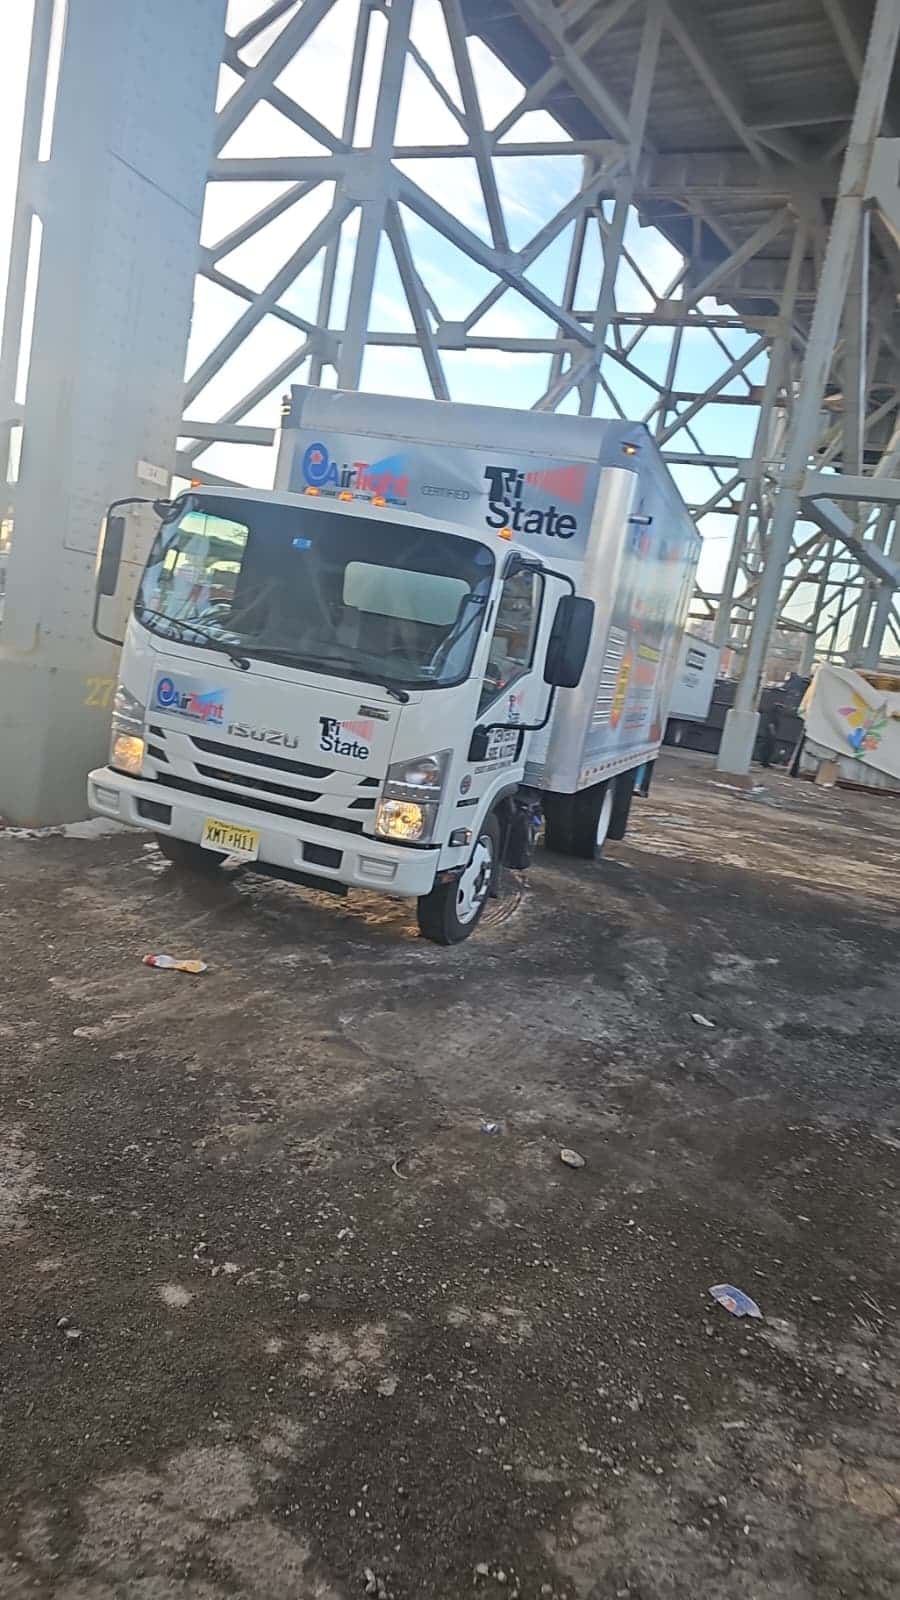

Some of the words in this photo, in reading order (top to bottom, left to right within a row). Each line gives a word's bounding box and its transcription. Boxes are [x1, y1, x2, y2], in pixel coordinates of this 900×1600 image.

[485, 497, 577, 540] State
[227, 722, 299, 749] ISUZU
[319, 736, 369, 760] State
